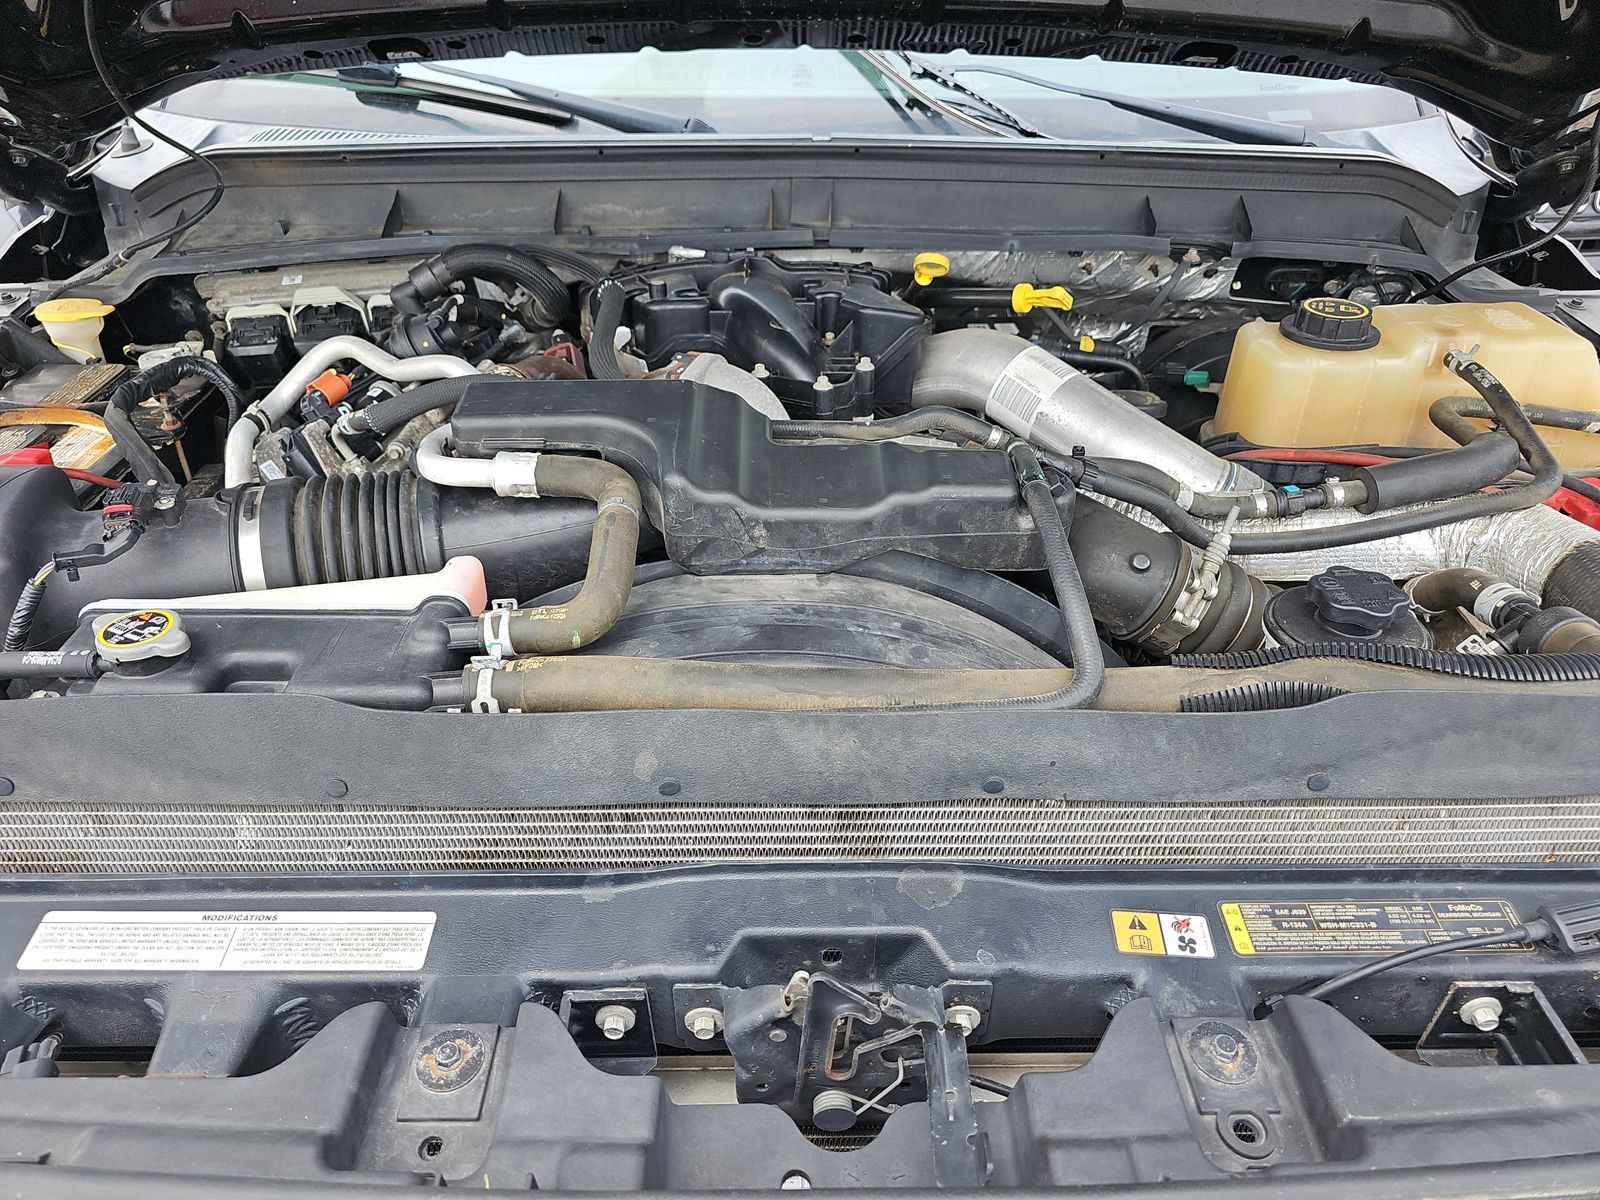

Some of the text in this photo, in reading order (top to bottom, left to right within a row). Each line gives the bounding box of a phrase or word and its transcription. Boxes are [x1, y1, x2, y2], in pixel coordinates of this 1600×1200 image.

[1447, 904, 1484, 912] FoMoCo
[202, 914, 279, 922] MODIFICATIONS
[1281, 921, 1308, 929] R-134A
